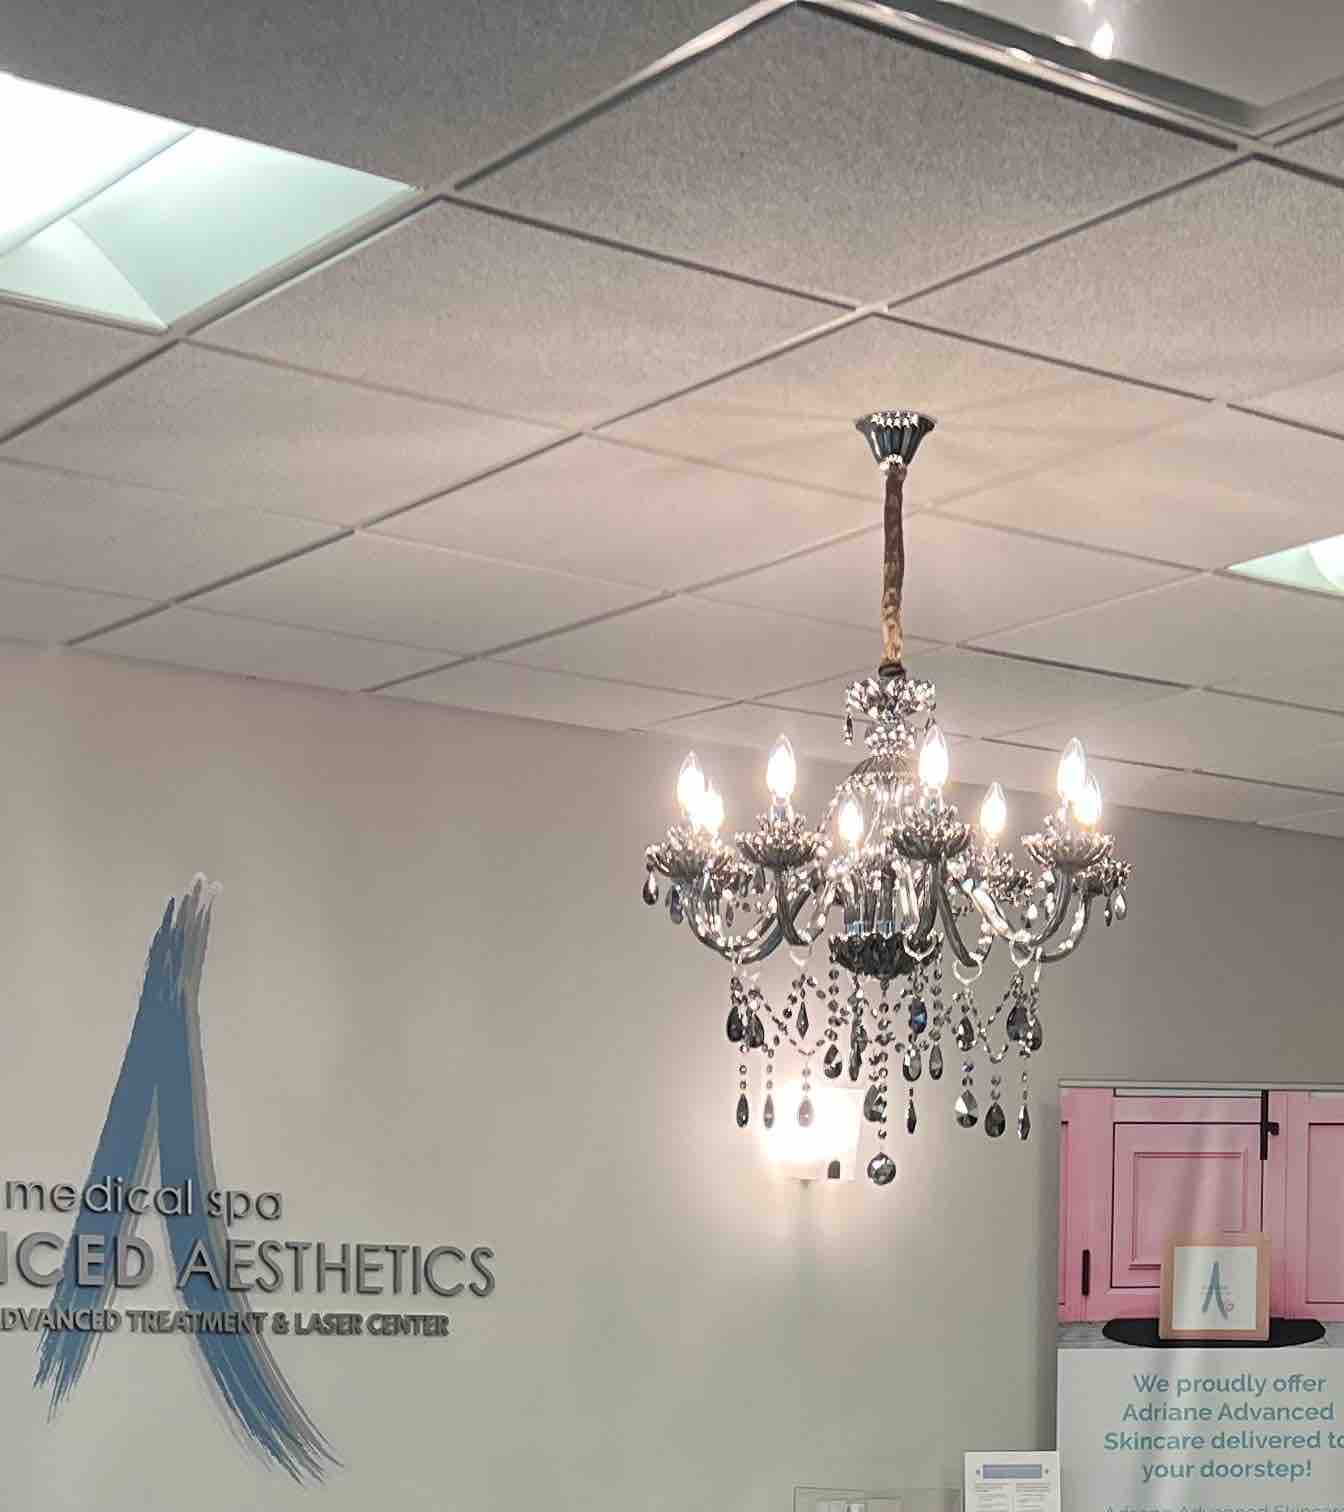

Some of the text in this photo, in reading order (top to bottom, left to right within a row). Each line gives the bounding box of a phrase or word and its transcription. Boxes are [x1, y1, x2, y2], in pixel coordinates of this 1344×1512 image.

[4, 1175, 283, 1227] medical spa
[176, 1239, 496, 1298] AESTHETICS
[126, 1310, 269, 1335] TREATMENT
[271, 1312, 290, 1336] &
[294, 1313, 362, 1337] LASER
[366, 1313, 450, 1338] CENTER
[1134, 1373, 1327, 1398] We proudly offer
[1122, 1402, 1335, 1422] Adriane Advanced
[1104, 1432, 1206, 1450] Skincare
[1211, 1431, 1321, 1449] delivered
[1142, 1459, 1312, 1483] your doorstep!
